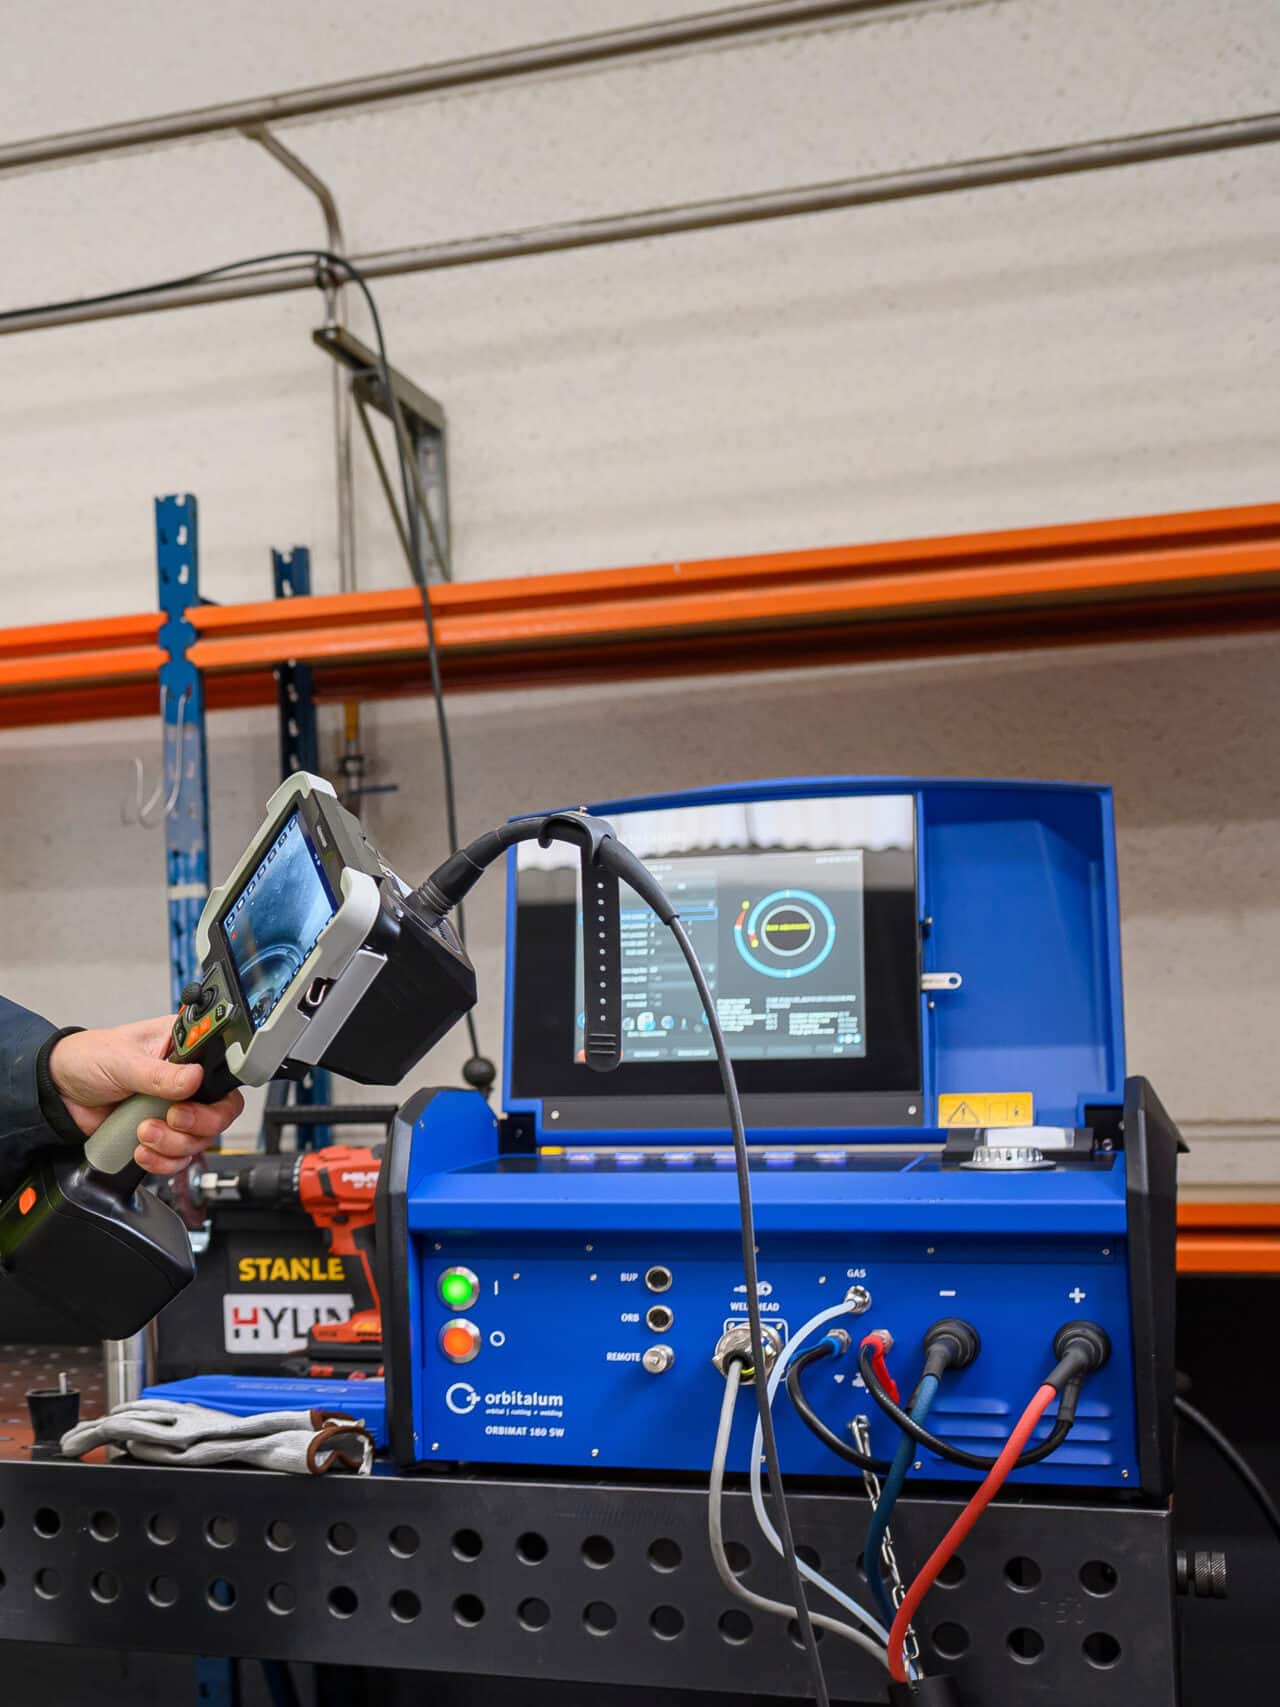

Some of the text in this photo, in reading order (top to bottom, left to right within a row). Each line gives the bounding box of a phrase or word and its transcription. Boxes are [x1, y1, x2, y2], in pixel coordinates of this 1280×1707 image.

[238, 1257, 345, 1281] STANLE
[846, 1268, 867, 1278] GAS
[620, 1272, 638, 1282] BUP
[730, 1302, 780, 1312] WELHEAD
[620, 1313, 640, 1322] ORB
[606, 1351, 641, 1362] REMOTE
[484, 1390, 564, 1406] orbitalum
[485, 1426, 528, 1436] ORBIMAT
[548, 1427, 565, 1437] SW
